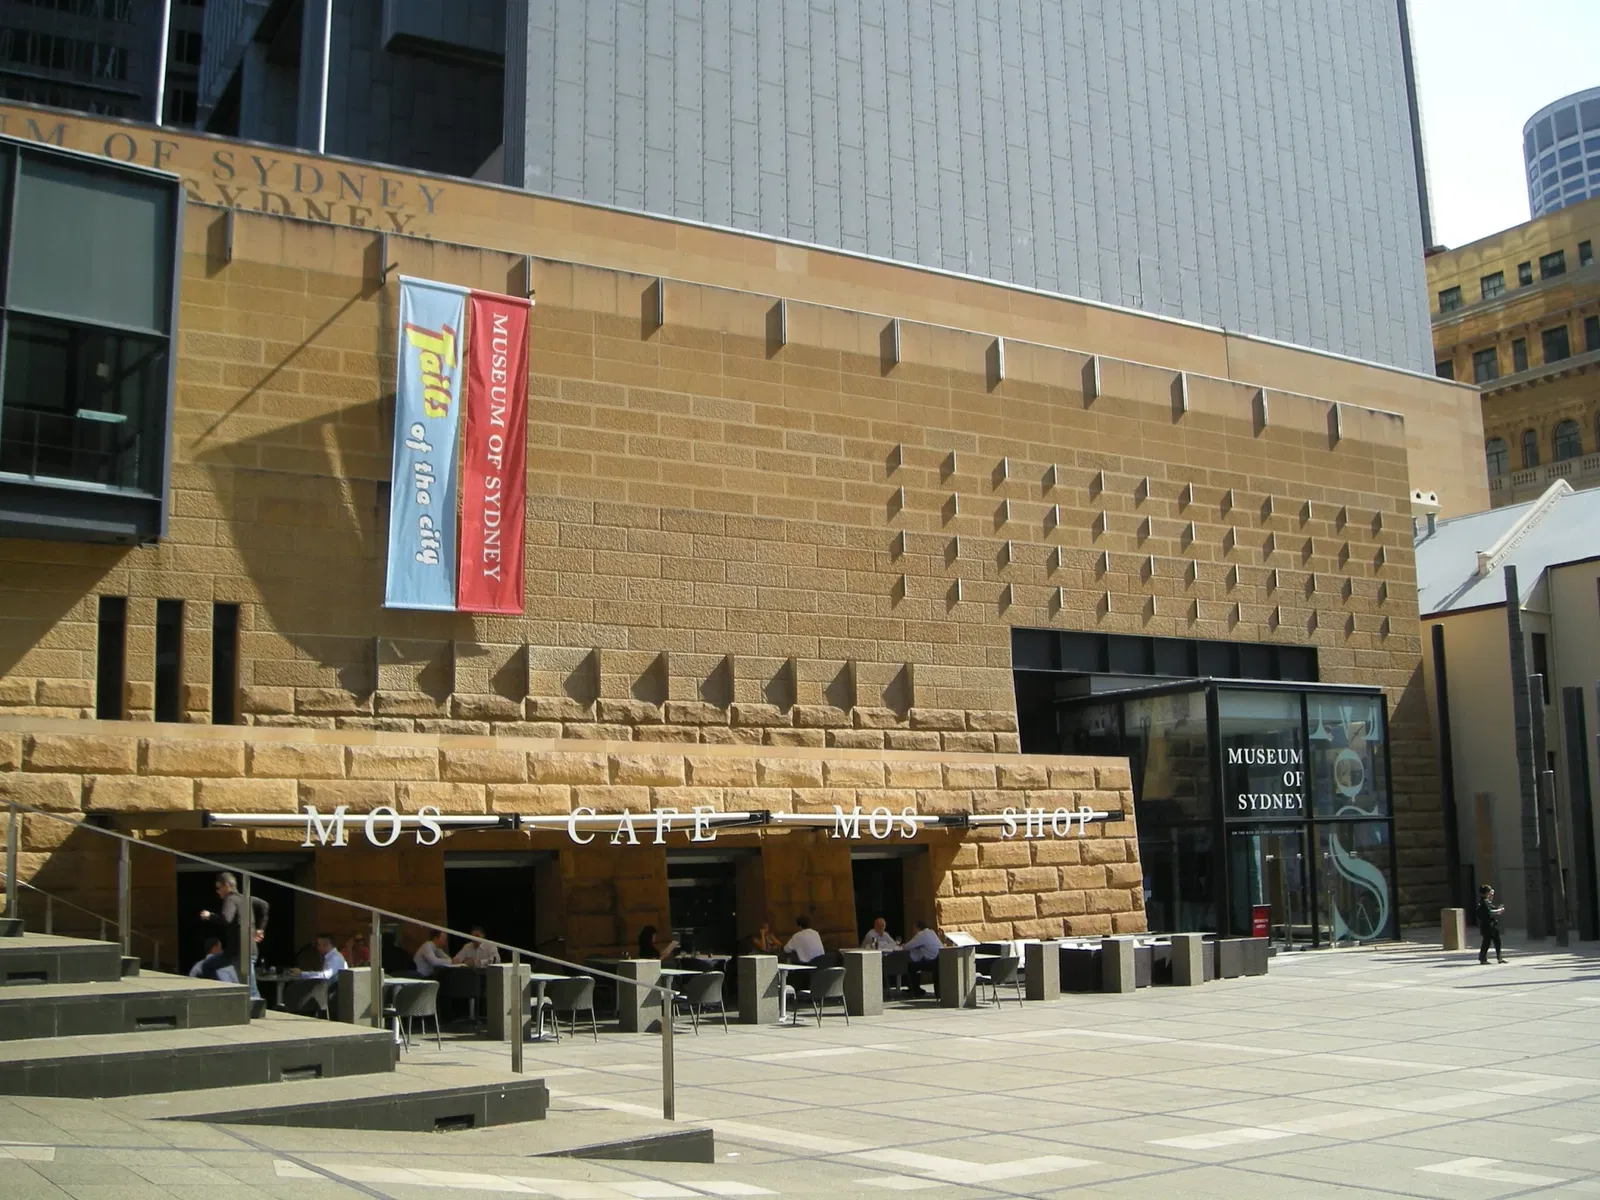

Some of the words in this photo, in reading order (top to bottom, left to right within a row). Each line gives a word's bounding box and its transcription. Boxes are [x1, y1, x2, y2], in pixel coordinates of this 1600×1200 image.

[104, 131, 180, 169] OF
[212, 150, 444, 215] SYDNEY
[404, 321, 457, 419] Tails
[490, 312, 508, 428] MUSEUM
[405, 422, 432, 453] of
[487, 435, 504, 470] OF
[414, 460, 436, 506] the
[415, 512, 441, 566] city
[482, 475, 502, 582] SYDNEY
[1228, 748, 1304, 765] MUSEUM
[1283, 771, 1305, 787] OF
[832, 804, 920, 839] MOS
[1001, 806, 1094, 838] SHOP
[1238, 793, 1306, 810] SYDNEY
[301, 805, 442, 848] MOS
[567, 805, 718, 846] CAFE
